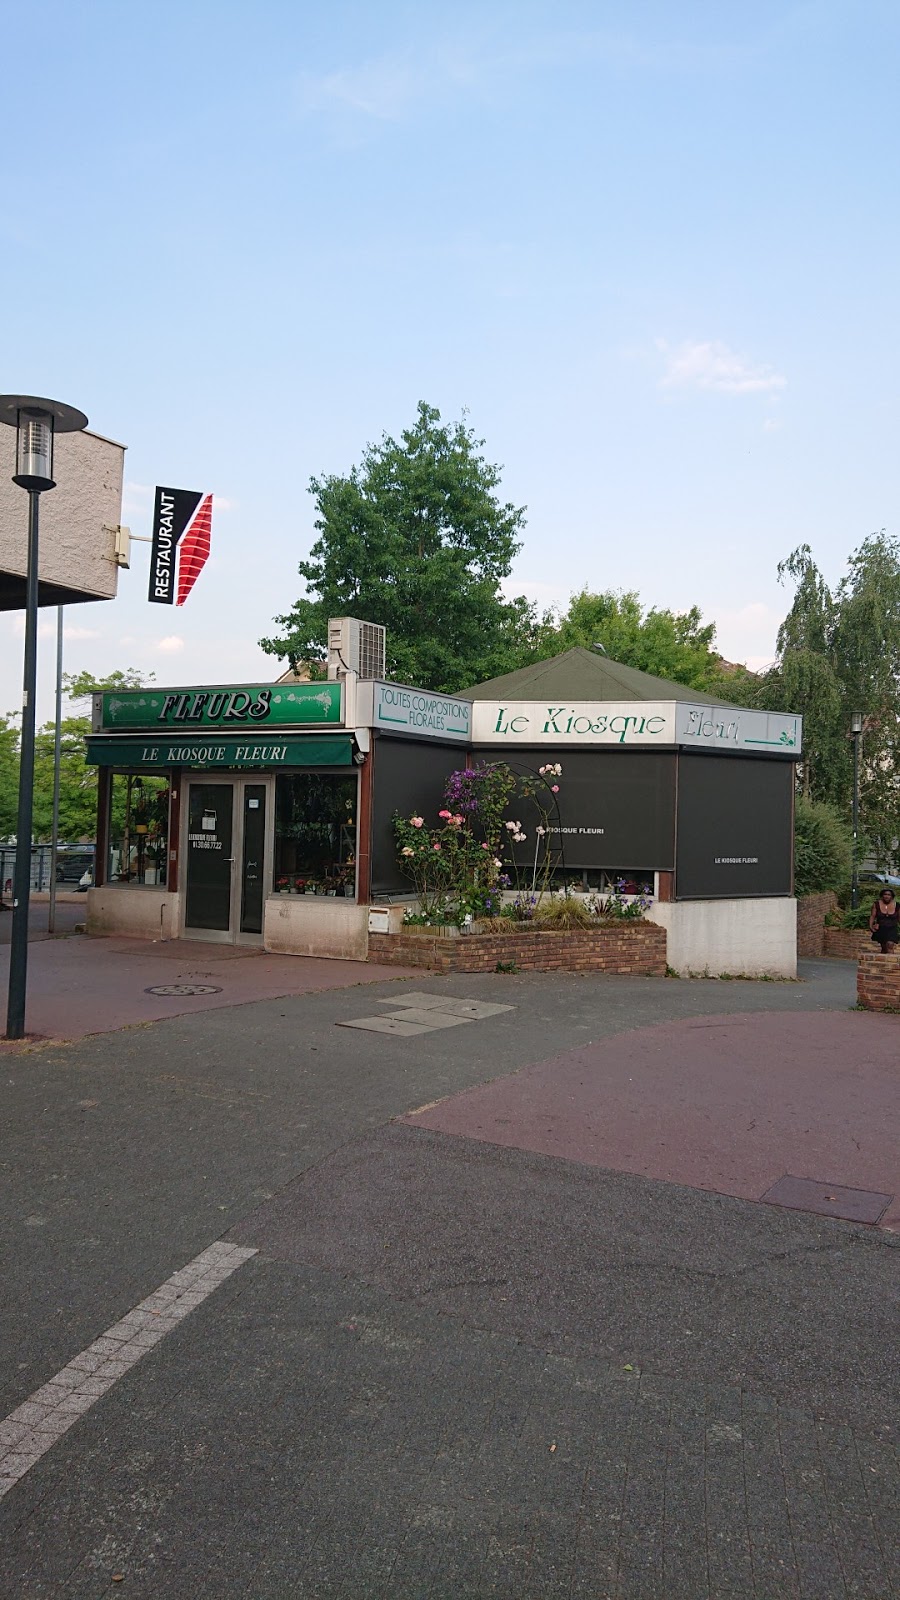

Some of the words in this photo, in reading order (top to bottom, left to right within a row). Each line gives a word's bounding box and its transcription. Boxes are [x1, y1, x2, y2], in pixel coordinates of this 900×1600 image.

[155, 492, 174, 597] RESTAURANT
[157, 689, 272, 720] FLEURS
[381, 688, 411, 710] TOUTES
[412, 696, 469, 719] COMPOSITIONS
[409, 711, 445, 731] FLORALES
[492, 708, 529, 734] Le
[540, 708, 666, 743] Kiosque
[142, 748, 159, 761] LE
[167, 747, 226, 764] KIOSQUE
[235, 746, 288, 760] FLEURI
